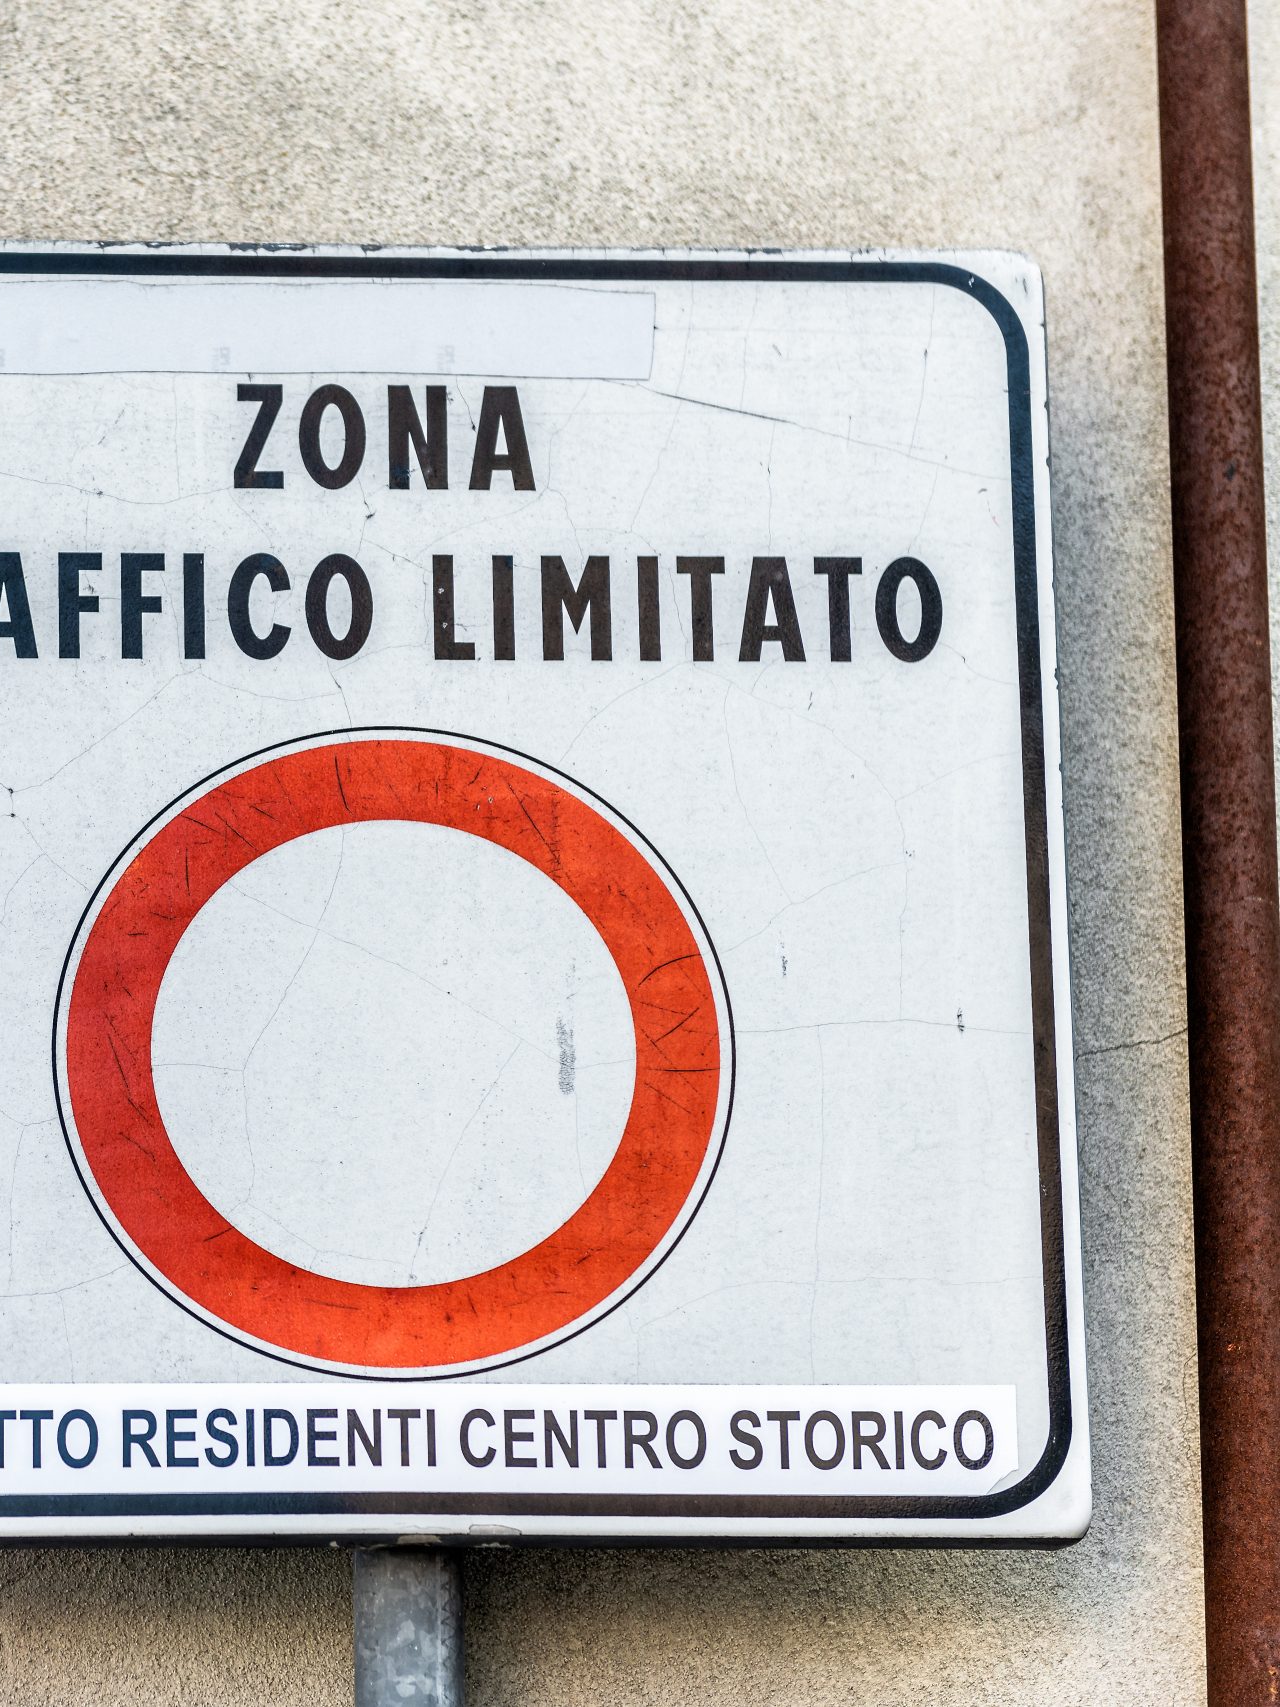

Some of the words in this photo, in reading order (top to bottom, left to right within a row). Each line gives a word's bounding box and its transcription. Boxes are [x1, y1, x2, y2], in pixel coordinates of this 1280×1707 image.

[234, 383, 538, 491] ZONA
[433, 554, 943, 663] LIMITATO
[122, 1408, 437, 1469] RESIDENTI
[459, 1408, 707, 1470] CENTRO
[729, 1409, 994, 1471] STORICO
